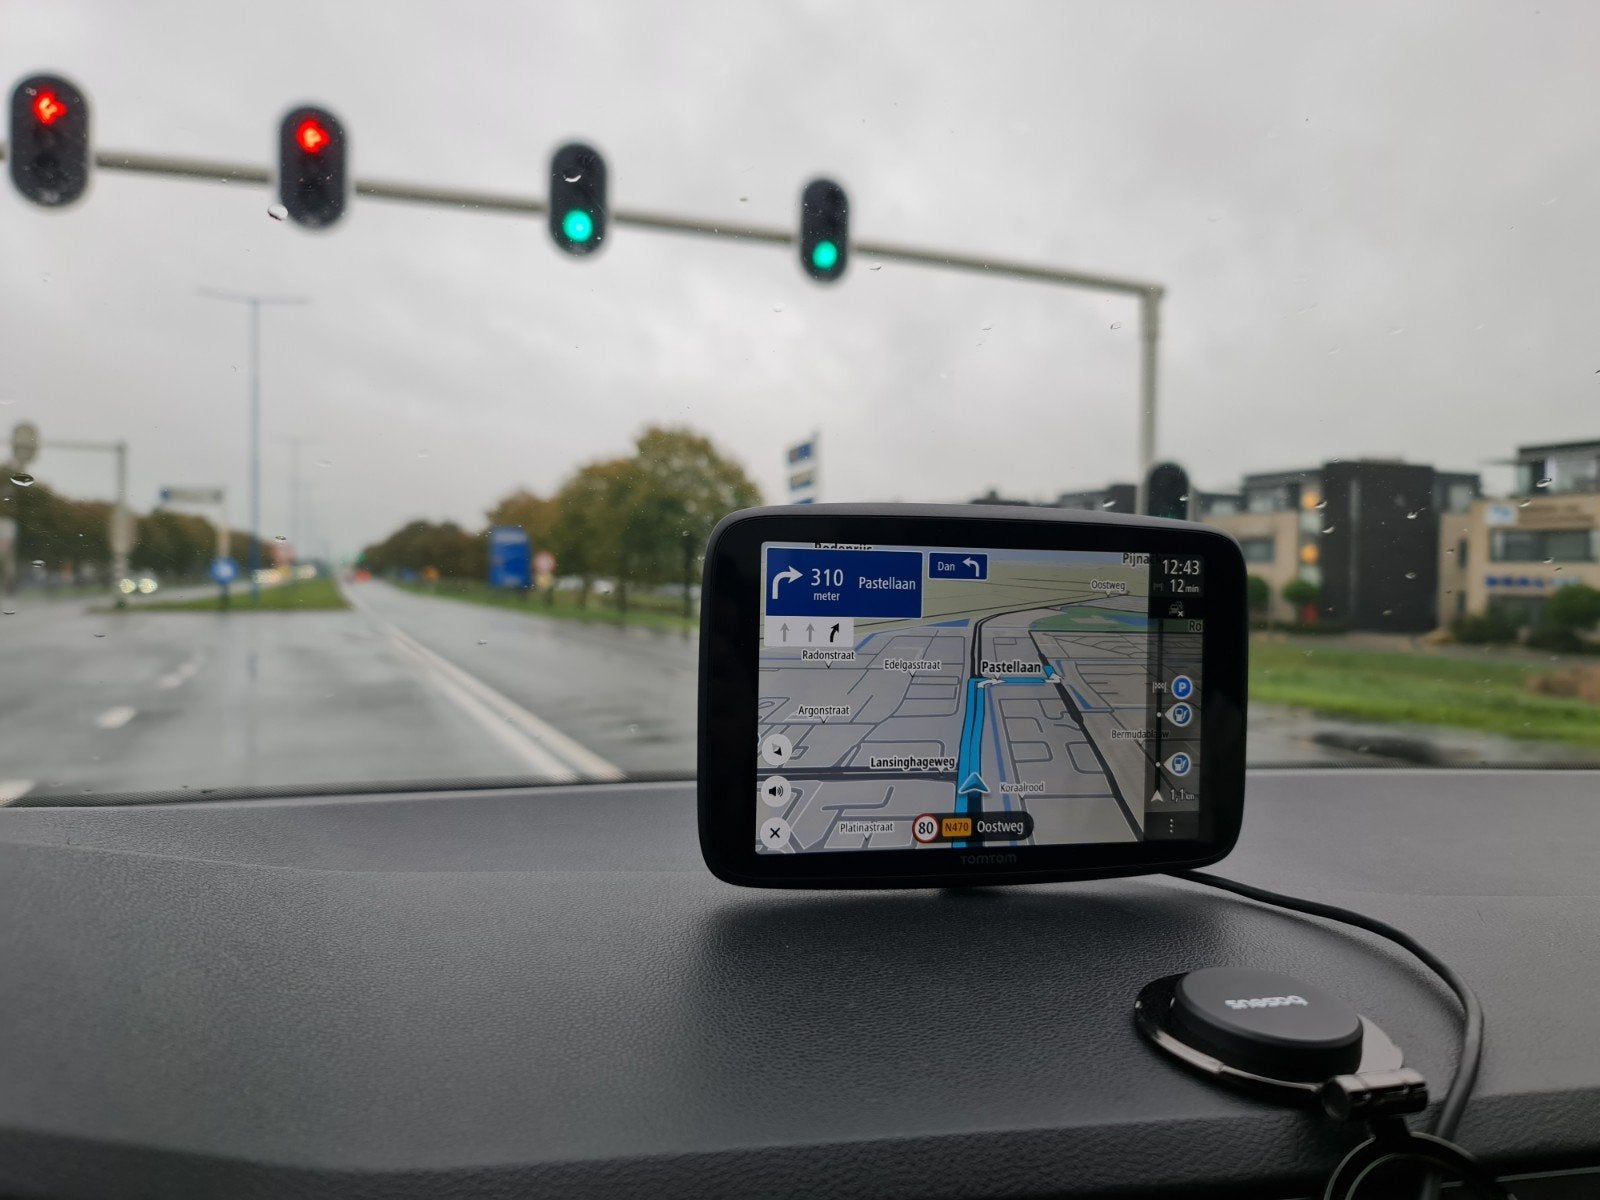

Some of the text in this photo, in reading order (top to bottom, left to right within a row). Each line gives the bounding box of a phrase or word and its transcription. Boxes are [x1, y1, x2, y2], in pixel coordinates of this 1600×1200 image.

[937, 561, 956, 572] Dan
[1162, 559, 1200, 575] 12:43
[810, 568, 844, 587] 310
[858, 576, 916, 590] Pastellaan
[1091, 580, 1126, 591] Oostweg
[1170, 579, 1200, 593] 12 min
[813, 591, 841, 601] meter
[802, 650, 855, 660] Radonstraat
[884, 660, 941, 671] Edelgasstraat
[981, 661, 1041, 673] Pastellaan
[798, 705, 850, 717] Argonstraat
[1111, 729, 1169, 739] Bermudablaw
[870, 757, 956, 769] Lansinghageweg
[1000, 783, 1044, 792] Koraalrood
[840, 822, 893, 833] Platinastraat
[918, 821, 934, 835] 80
[944, 822, 969, 832] N470
[977, 820, 1024, 834] Oostweg
